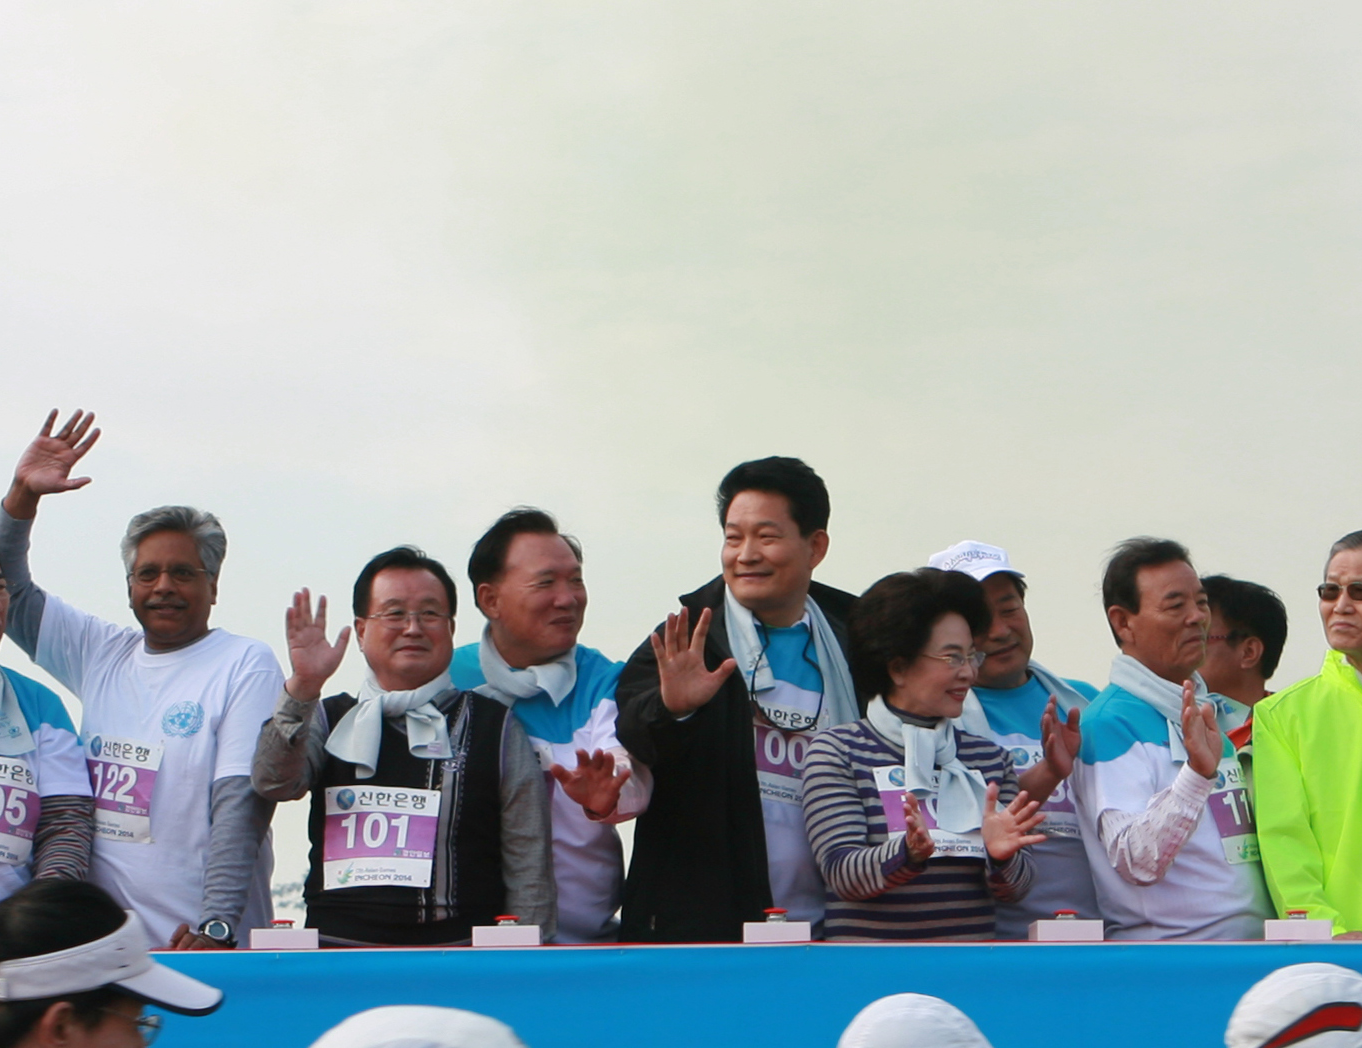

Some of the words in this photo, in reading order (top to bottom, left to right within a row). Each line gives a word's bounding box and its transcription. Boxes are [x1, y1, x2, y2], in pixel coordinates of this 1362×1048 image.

[103, 740, 150, 762] 신한은행
[94, 763, 137, 804] 122
[358, 791, 427, 810] 신한은행
[341, 812, 410, 850] 101
